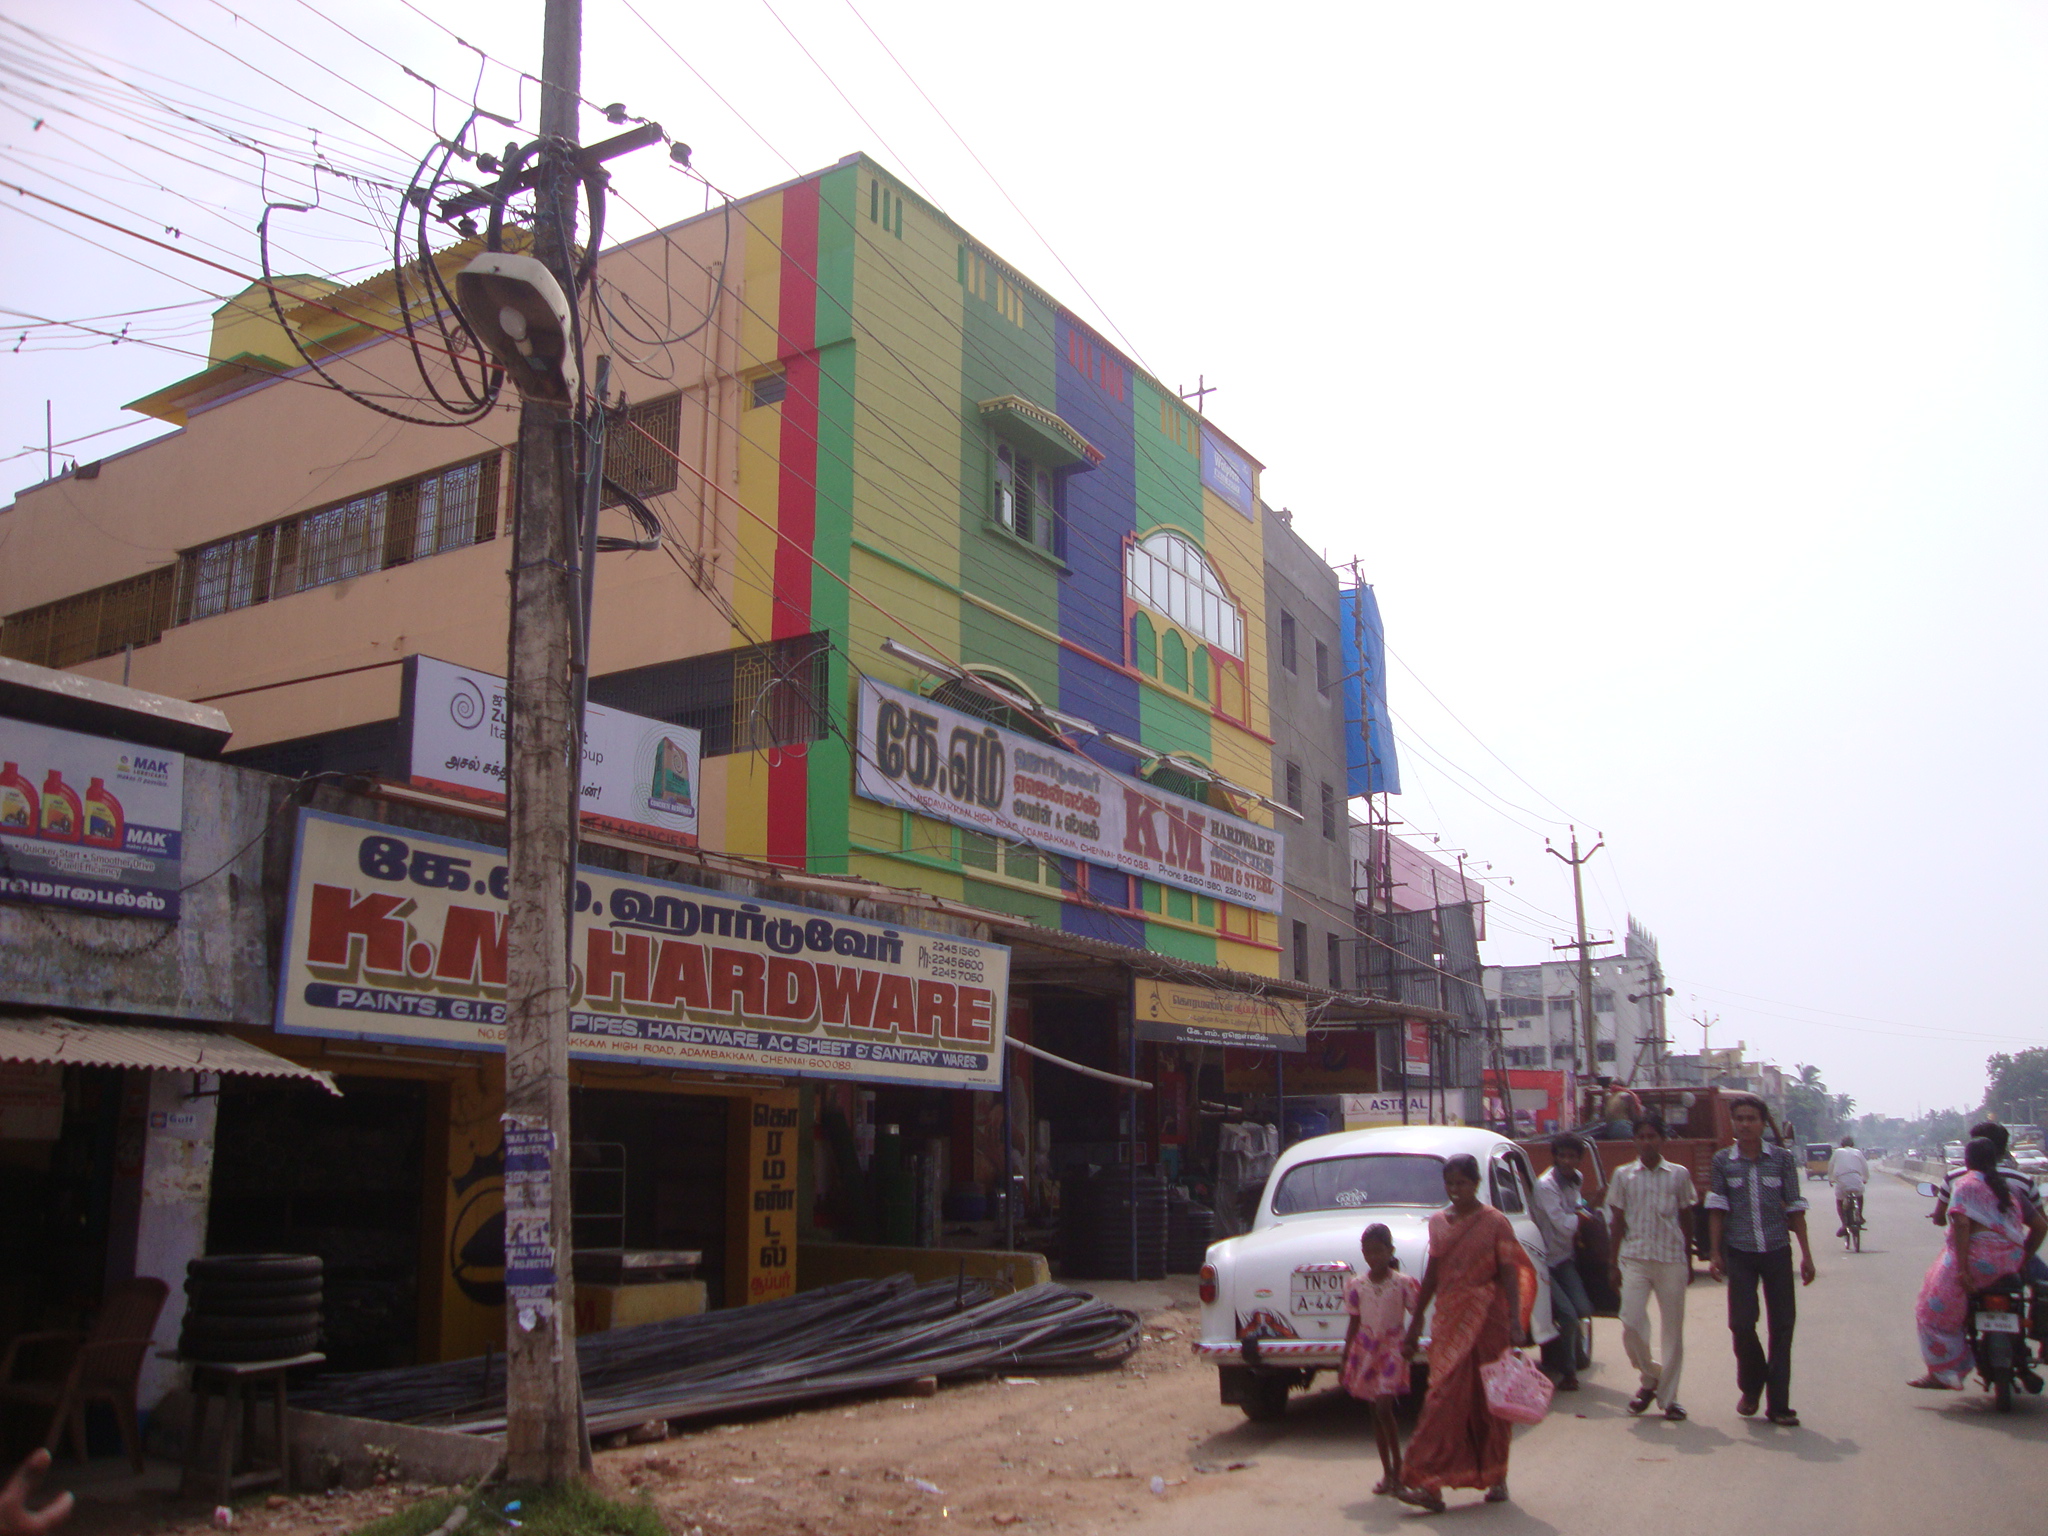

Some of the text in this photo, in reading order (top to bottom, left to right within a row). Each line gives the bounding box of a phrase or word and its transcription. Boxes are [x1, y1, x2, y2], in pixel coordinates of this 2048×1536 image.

[134, 757, 169, 774] MAK
[1055, 812, 1064, 831] &
[1122, 787, 1207, 876] KM
[127, 828, 167, 848] MAK
[1210, 819, 1275, 857] HARDWARE
[23, 843, 155, 871] Quicker Start Smoother Drive
[1210, 840, 1274, 877] AGENCIES
[58, 861, 121, 879] Fuel Efficiency
[1210, 859, 1275, 896] IRON & STEEL
[932, 955, 984, 971] 22456600
[931, 966, 984, 983] 22457050
[337, 989, 443, 1018] PAINTS,
[571, 1014, 642, 1038] PIPES,
[648, 1023, 763, 1049] HARDWARE,
[767, 1035, 793, 1052] AC
[796, 1037, 852, 1057] SHEET
[855, 1045, 868, 1059] &
[872, 1046, 938, 1064] SANITARY
[942, 1053, 978, 1069] WARES.
[612, 1041, 638, 1052] HIGH
[643, 1043, 676, 1057] ROAD,
[680, 1047, 758, 1063] ADAMBAKKAM,
[169, 1114, 194, 1124] Gulf
[1297, 1295, 1345, 1311] A-447
